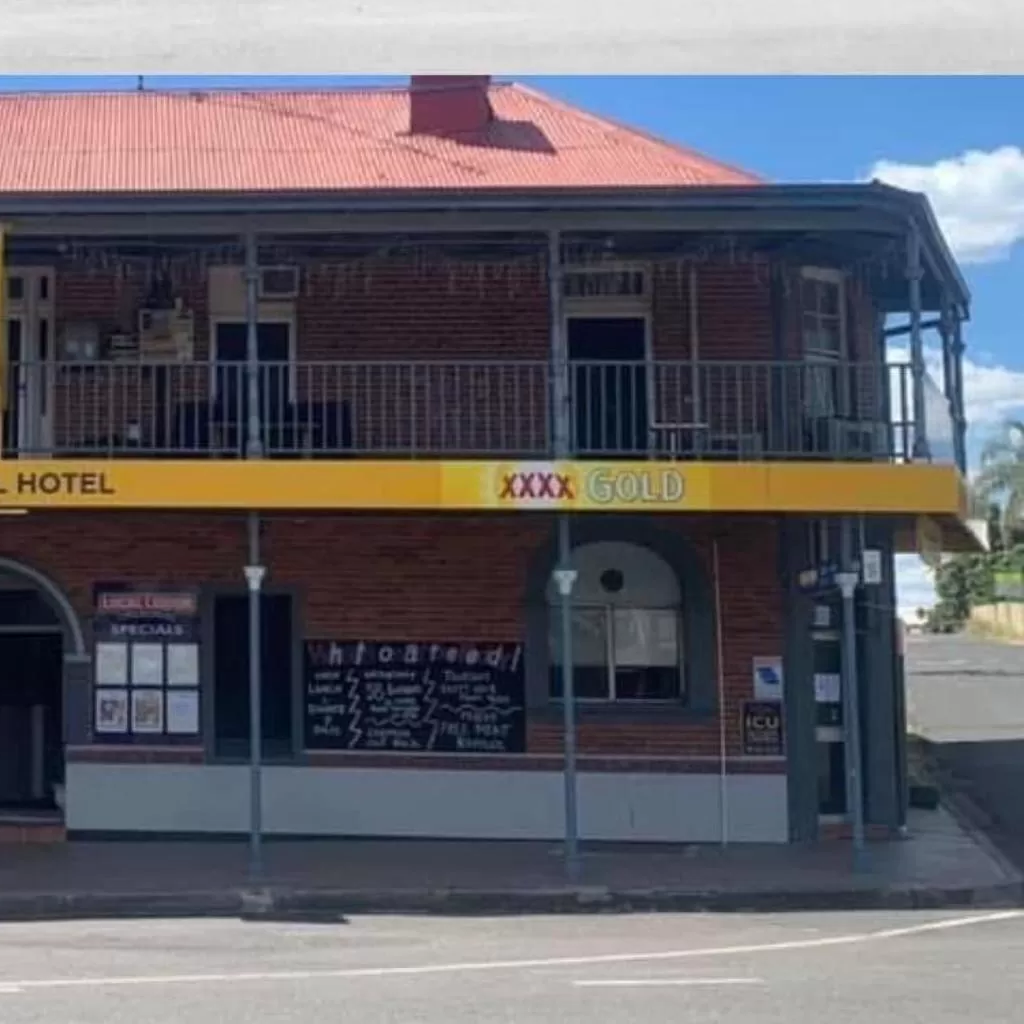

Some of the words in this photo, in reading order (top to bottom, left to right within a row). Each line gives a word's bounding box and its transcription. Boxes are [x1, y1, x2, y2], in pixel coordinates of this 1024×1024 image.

[16, 471, 115, 495] HOTEL
[499, 472, 575, 500] XXXX
[587, 467, 685, 503] GOLD
